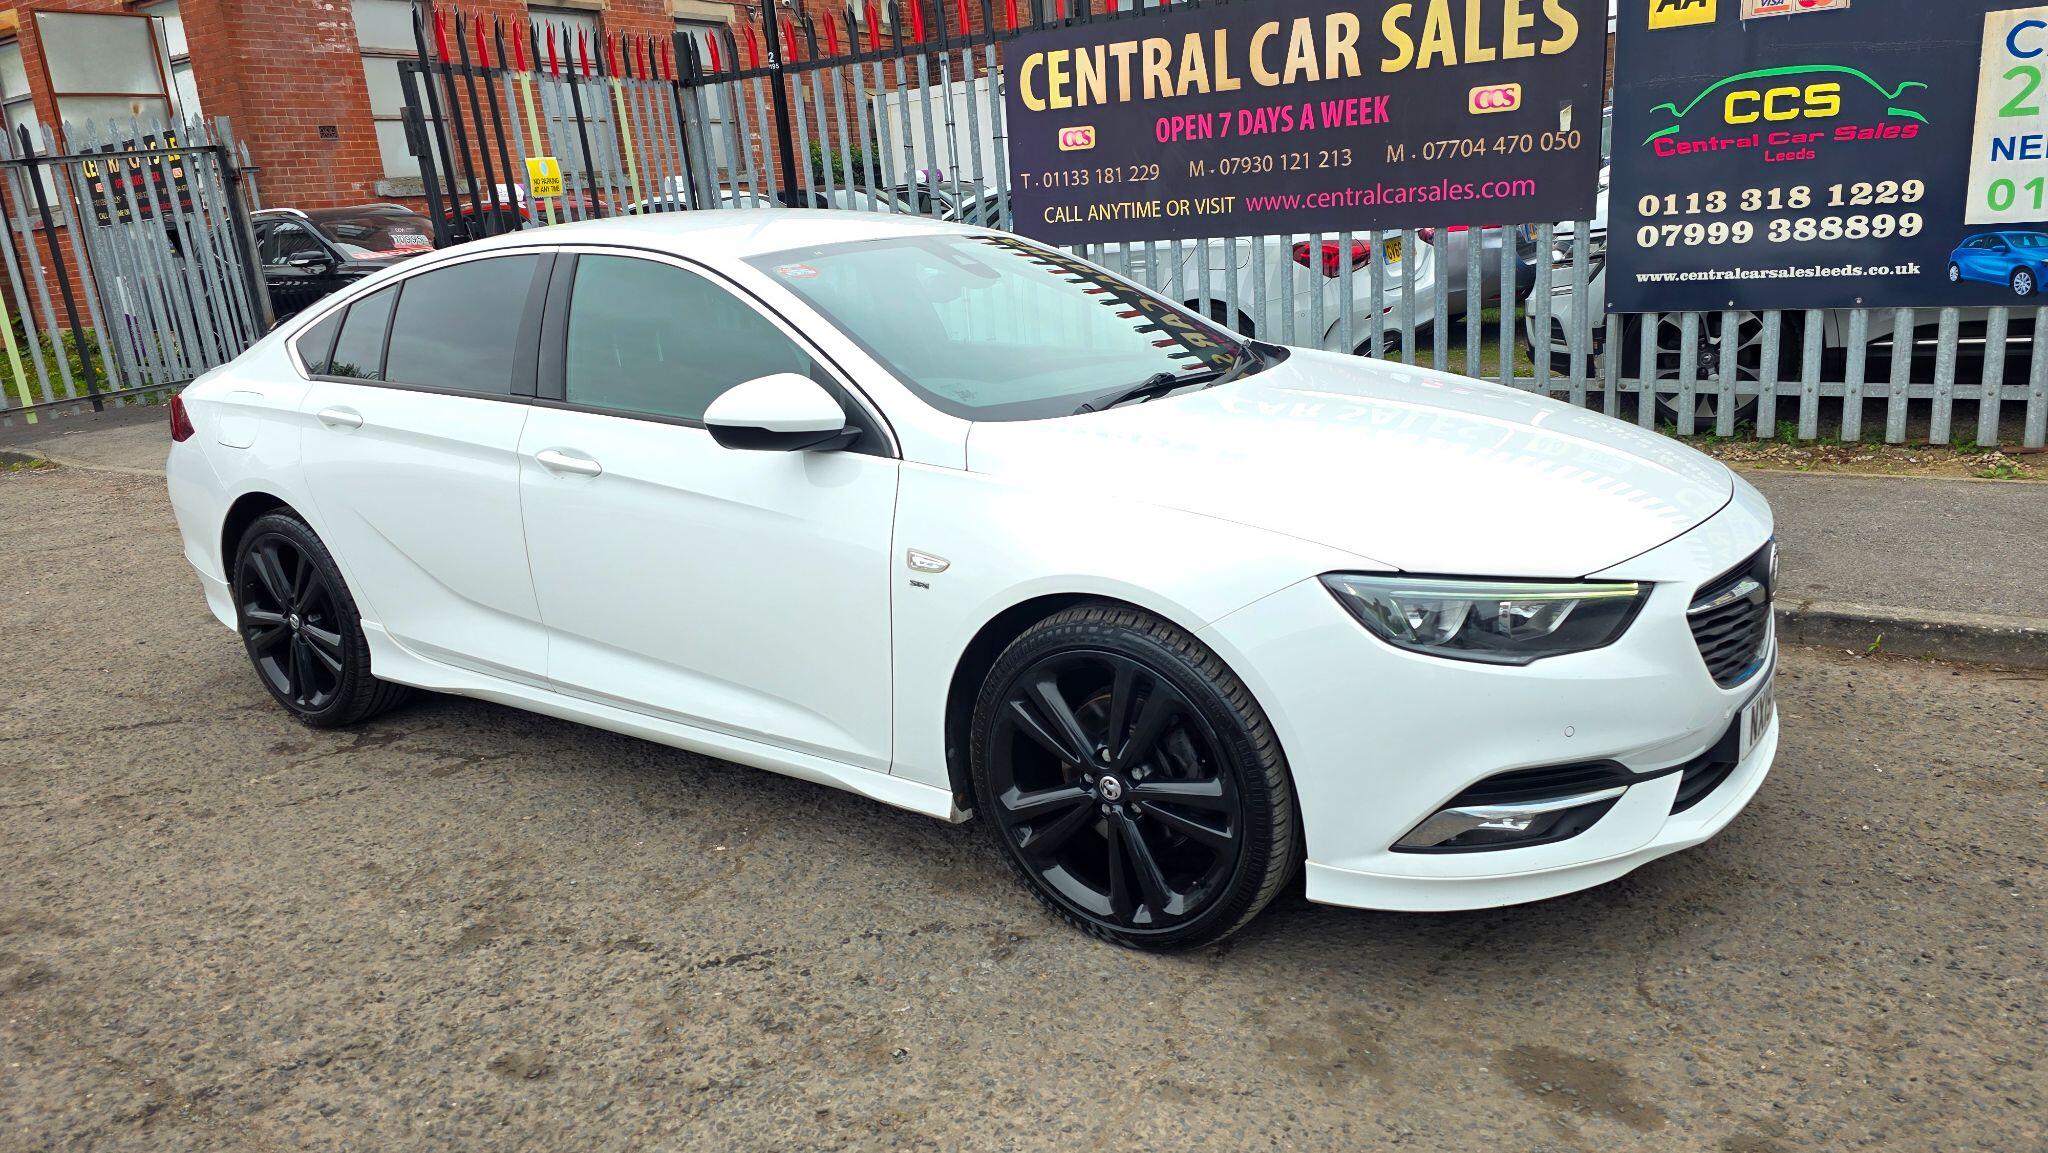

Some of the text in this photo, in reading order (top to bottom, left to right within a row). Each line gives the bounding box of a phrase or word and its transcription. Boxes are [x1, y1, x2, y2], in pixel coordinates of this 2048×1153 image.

[1019, 0, 1579, 111] CENTRAL CAR SALES
[2005, 20, 2048, 59] C
[1473, 87, 1516, 110] CCS
[1724, 82, 1840, 125] CCS
[1156, 95, 1390, 143] OPEN 7 DAYS A WEEK
[1062, 128, 1093, 148] CCS
[1423, 138, 1486, 160] 07704
[1493, 134, 1533, 155] 470
[1540, 130, 1581, 151] 050
[1654, 122, 1919, 157] Central Car Sales
[1991, 134, 2048, 162] NE
[1219, 155, 1272, 175] 07930
[1280, 152, 1310, 171] 121
[1319, 148, 1352, 168] 213
[1764, 148, 1815, 162] Leeds
[1043, 169, 1089, 187] 01133
[1096, 166, 1121, 184] 181
[1127, 163, 1160, 182] 229
[1044, 178, 1536, 223] CALL ANYTIME OR VISIT www.centralcarsales.com
[1638, 179, 1925, 217] 0113 318 1229
[1636, 212, 1923, 248] 07999 388899
[1636, 263, 1921, 283] www.centralcarsalesleeds.co.uk
